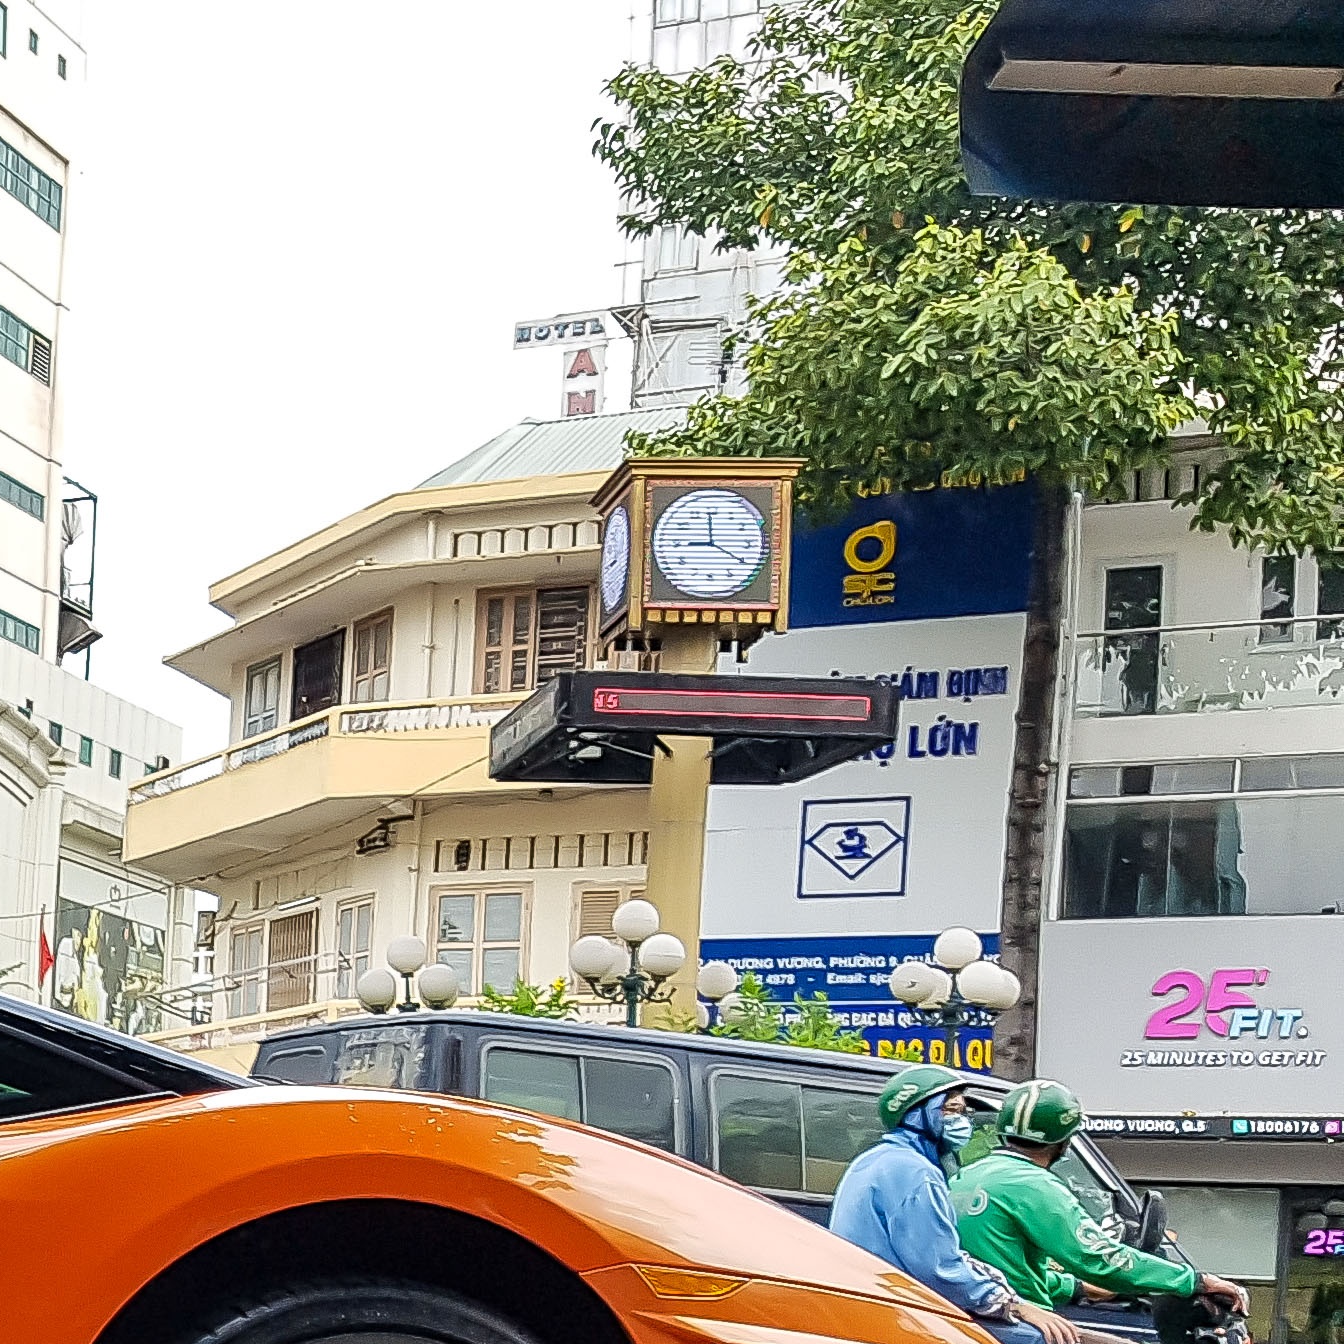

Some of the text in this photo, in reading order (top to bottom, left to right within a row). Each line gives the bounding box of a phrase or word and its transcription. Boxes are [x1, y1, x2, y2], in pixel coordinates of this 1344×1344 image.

[516, 318, 606, 343] HOTEL
[907, 714, 980, 759] LỚN
[1120, 1051, 1328, 1067] 25 MINUTES TO GET FIT
[1250, 1120, 1320, 1133] 18006176
